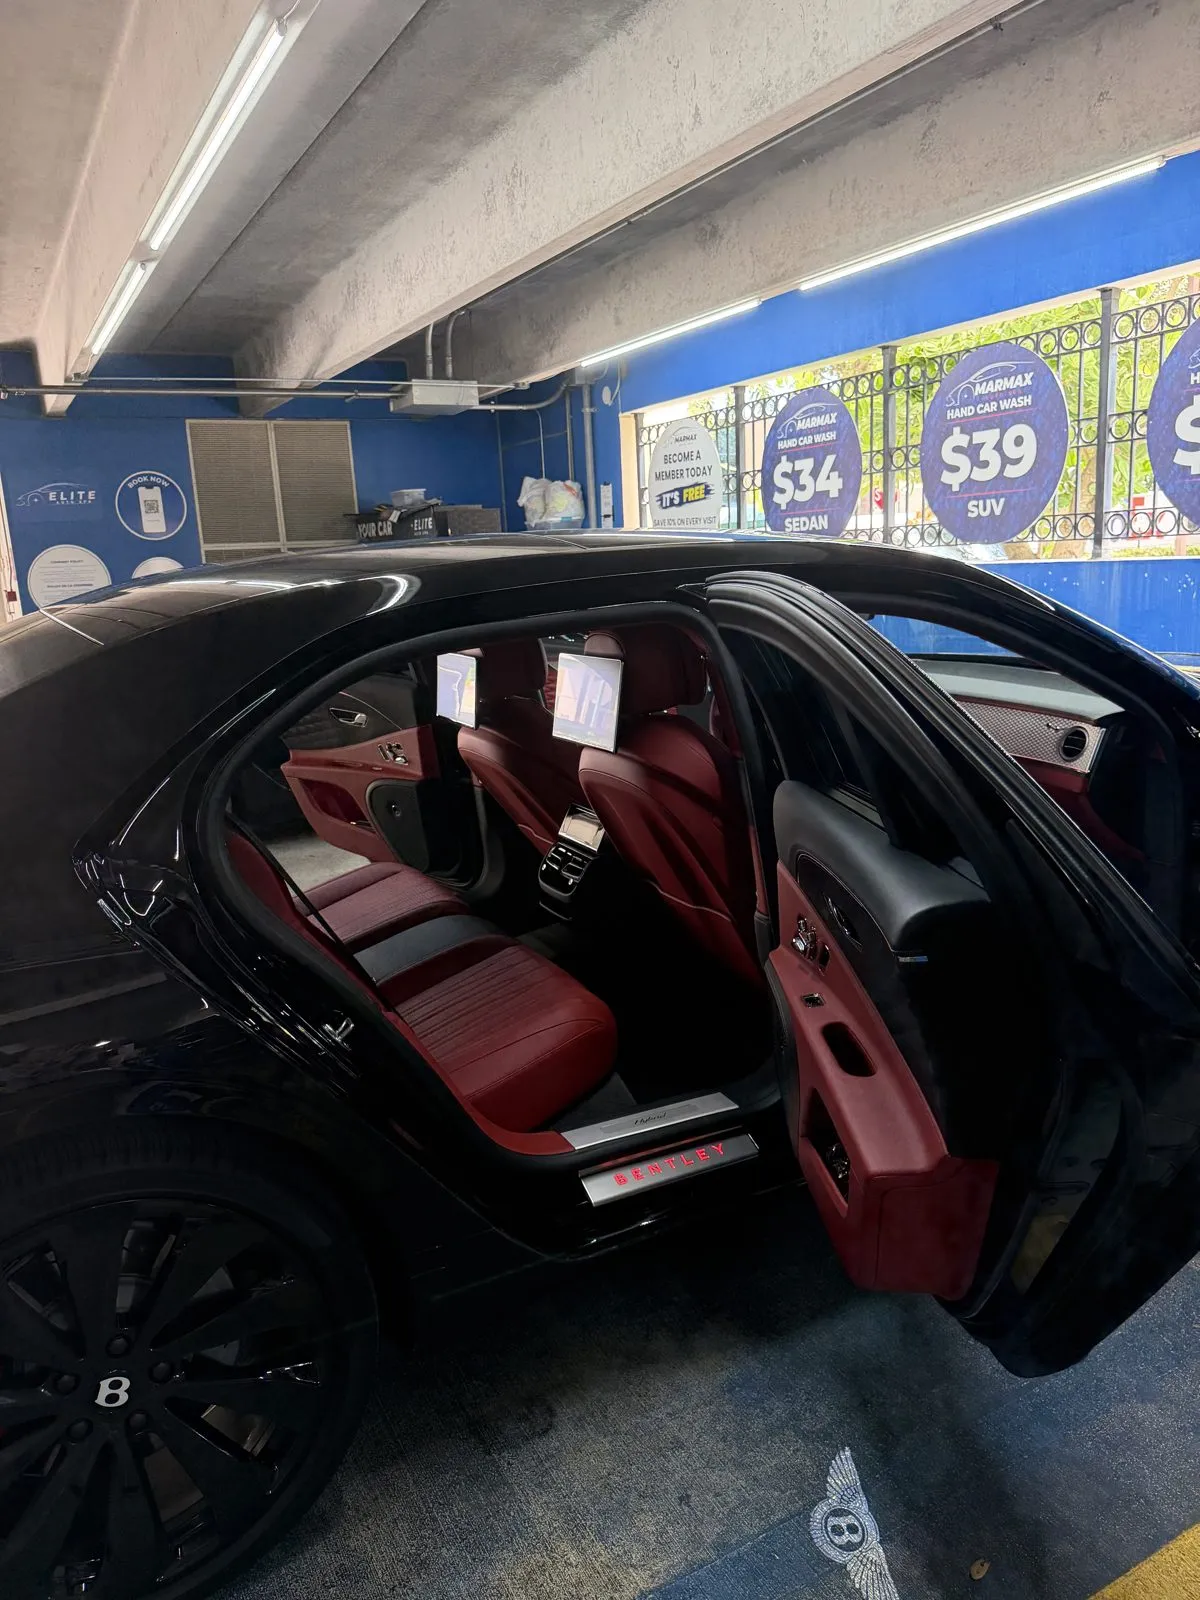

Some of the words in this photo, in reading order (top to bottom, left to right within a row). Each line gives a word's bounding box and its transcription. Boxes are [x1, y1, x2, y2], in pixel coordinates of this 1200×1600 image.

[974, 372, 1034, 396] MARMAX
[946, 406, 975, 420] HAND
[976, 401, 997, 415] CAR
[999, 394, 1032, 411] WASH
[796, 412, 837, 430] MARMAX
[778, 439, 797, 450] HAND
[798, 435, 813, 446] CAR
[814, 431, 836, 443] WASH
[663, 451, 694, 465] BECOME
[695, 450, 702, 461] A
[940, 423, 1037, 492] $39
[127, 475, 149, 489] BOOK
[150, 476, 170, 487] NOW
[655, 468, 684, 481] MEMBER
[686, 465, 713, 478] TODAY
[772, 454, 843, 510] $34
[49, 490, 96, 501] ELITE
[662, 491, 680, 507] IT'S
[683, 484, 706, 503] FREE
[967, 497, 1006, 518] SUV
[358, 523, 376, 538] YOUR
[377, 521, 393, 536] CAR
[413, 517, 433, 531] ELITE
[653, 519, 666, 527] SAVE
[677, 518, 685, 526] ON
[686, 517, 702, 526] EVERY
[703, 516, 717, 525] VISIT
[784, 514, 828, 532] SEDAN
[613, 1142, 724, 1187] BENTLEY
[94, 1376, 130, 1407] B
